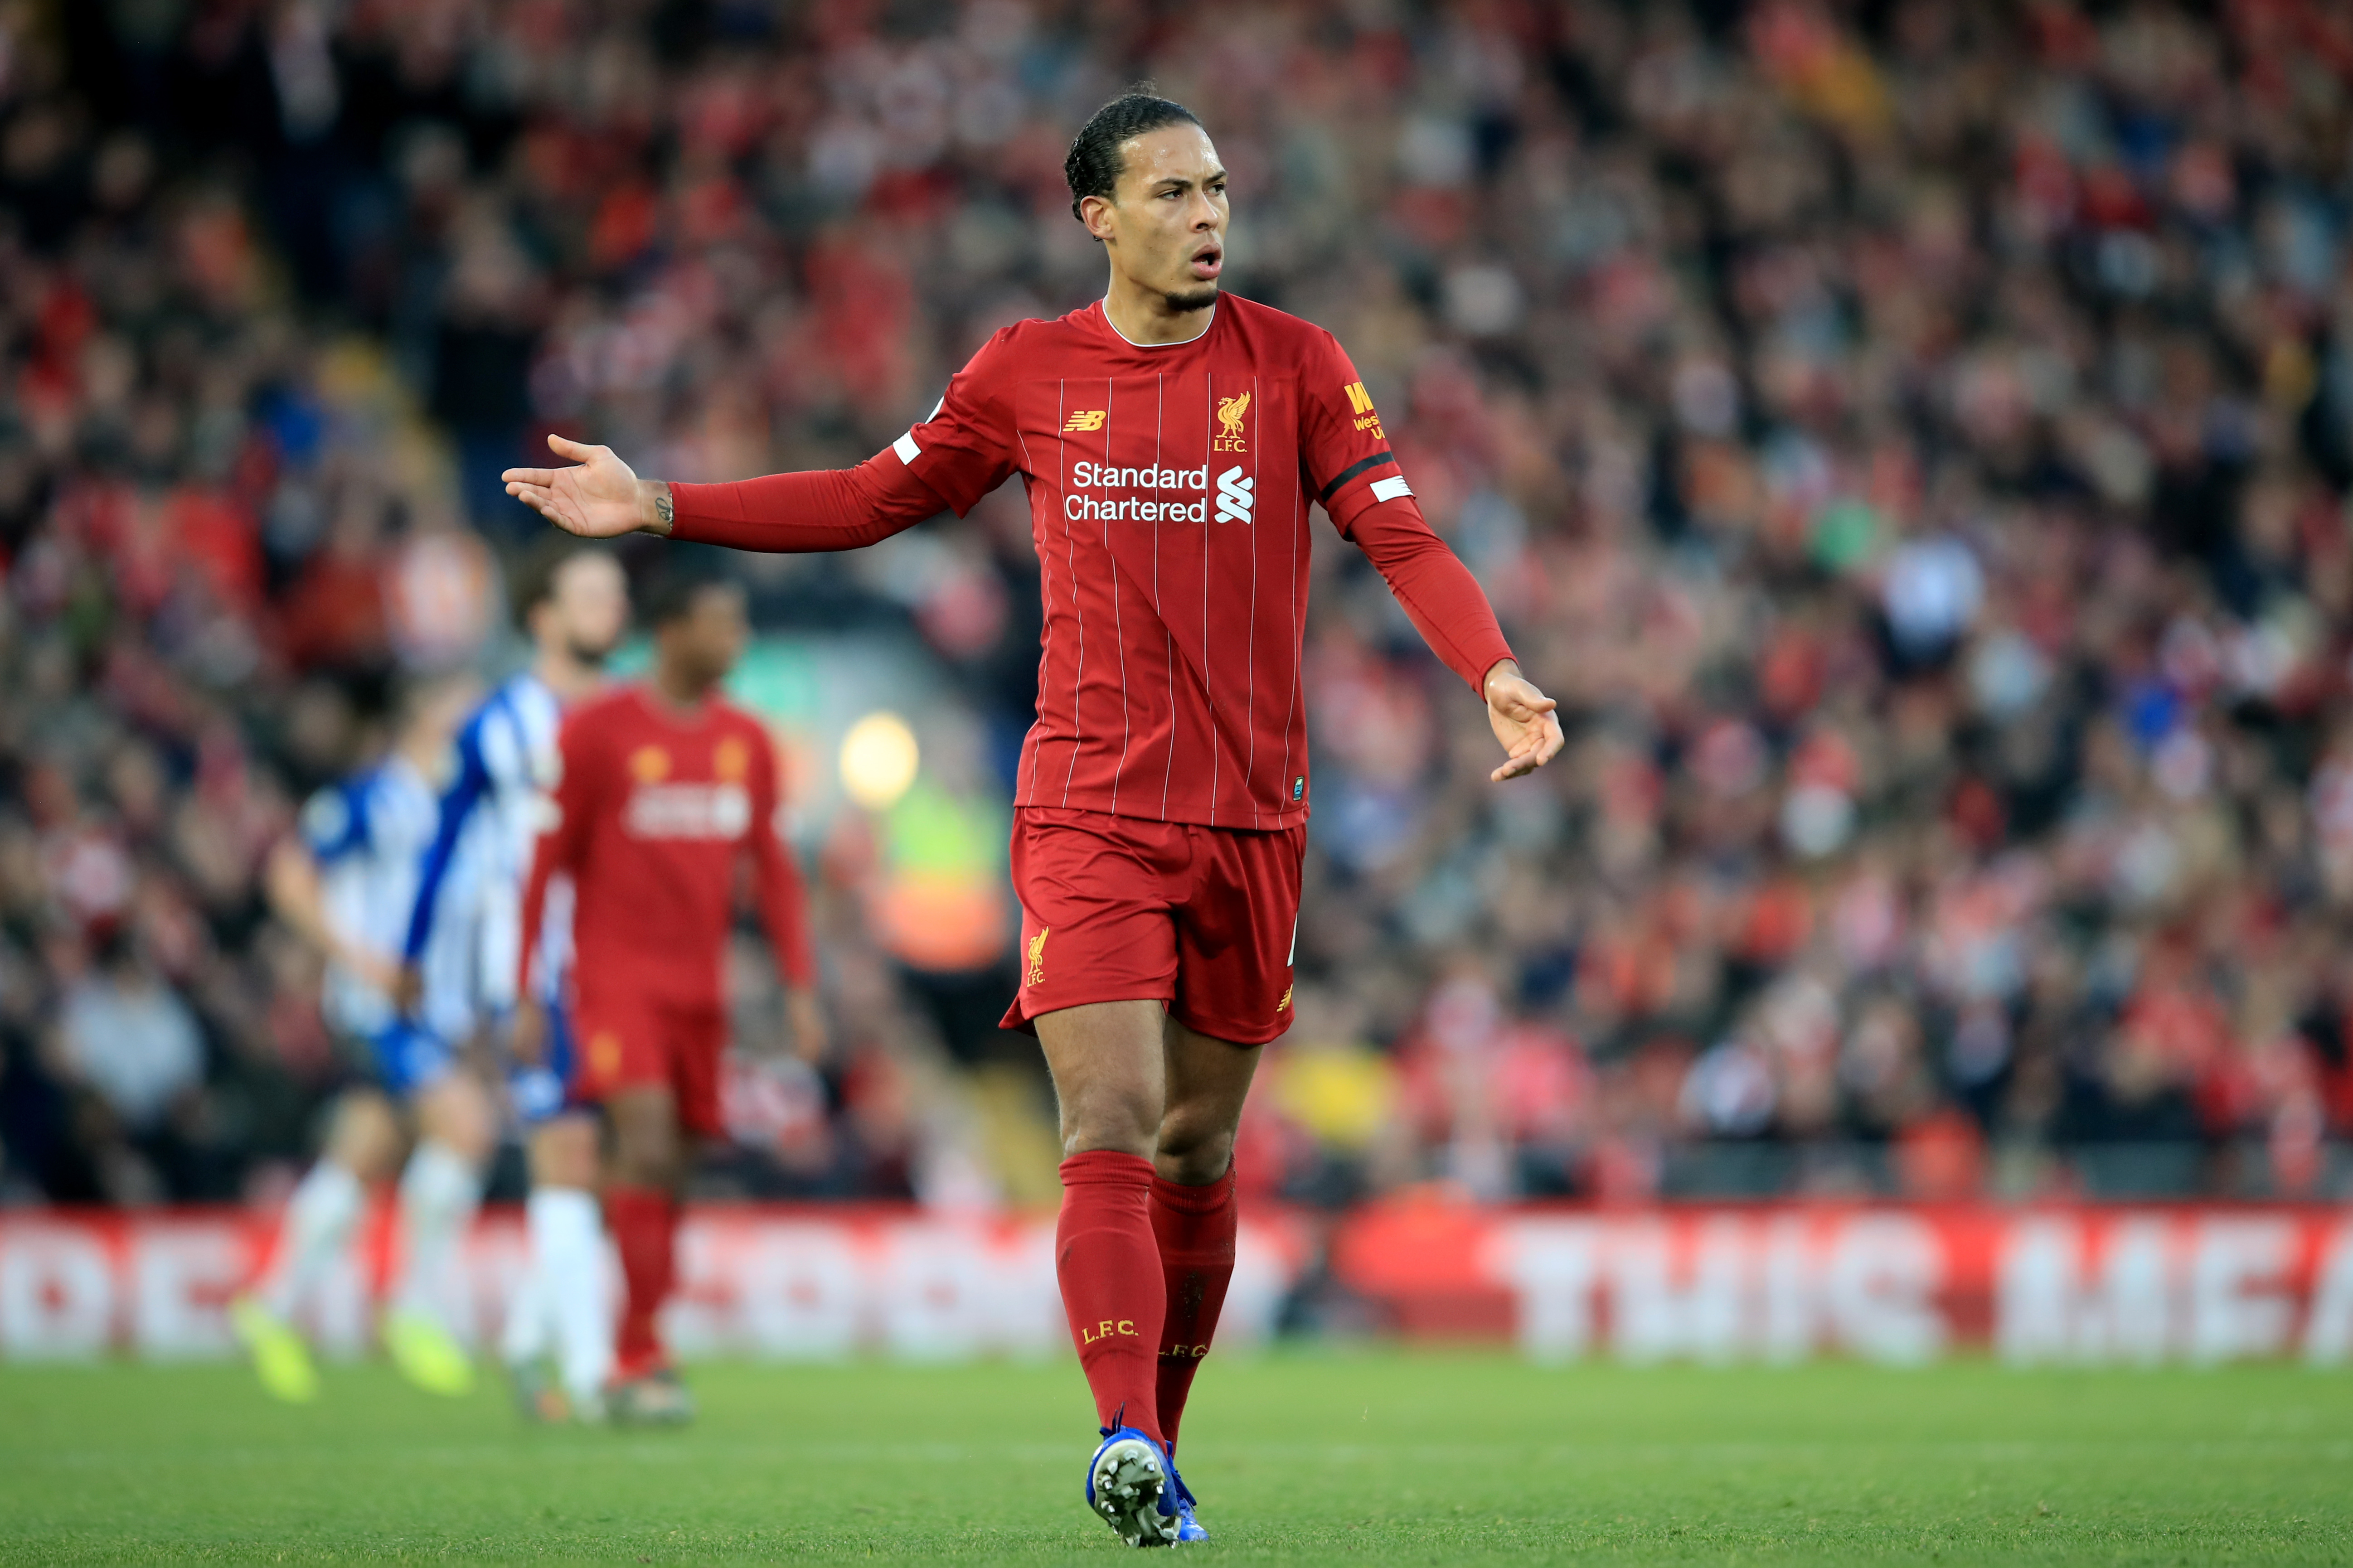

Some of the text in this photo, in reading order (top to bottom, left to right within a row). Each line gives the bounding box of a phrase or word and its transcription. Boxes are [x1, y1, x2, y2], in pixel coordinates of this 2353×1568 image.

[1353, 413, 1380, 431] Wes
[1213, 439, 1248, 452] L.F.C.
[1072, 461, 1207, 490] Standard
[1065, 494, 1207, 523] Chartered
[1479, 1212, 1948, 1364] THIS
[1082, 1320, 1139, 1345] L.F.C.
